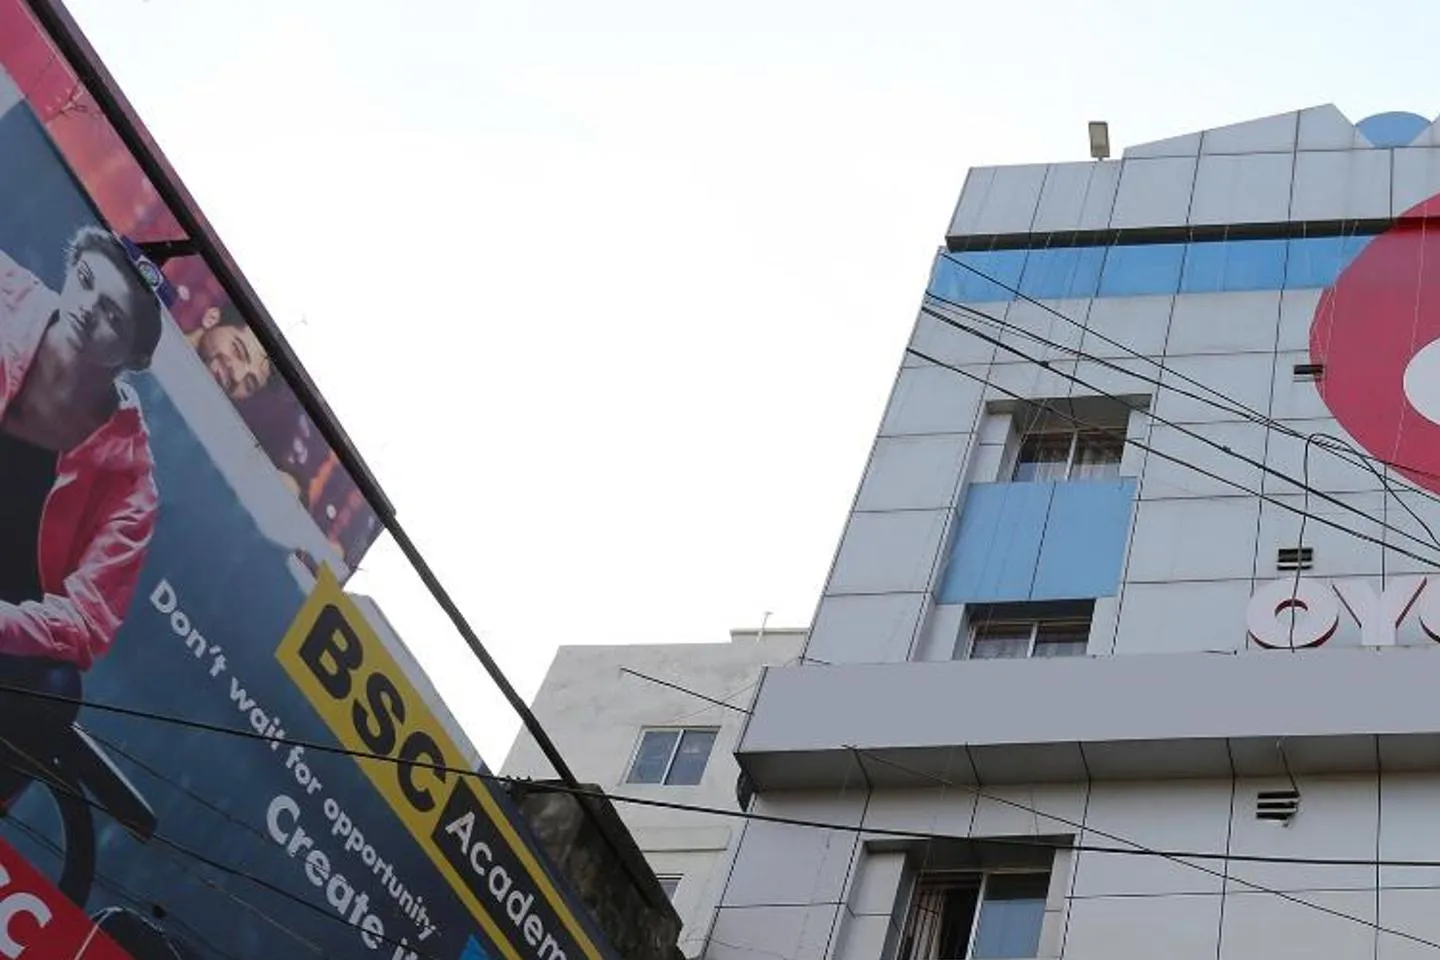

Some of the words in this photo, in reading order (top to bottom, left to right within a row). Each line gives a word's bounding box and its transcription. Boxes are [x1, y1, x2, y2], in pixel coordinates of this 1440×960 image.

[150, 578, 226, 677] Don't
[229, 677, 285, 750] wait
[286, 745, 322, 794] for
[324, 797, 438, 941] opportunity
[299, 604, 446, 813] BSC
[267, 795, 385, 949] Create
